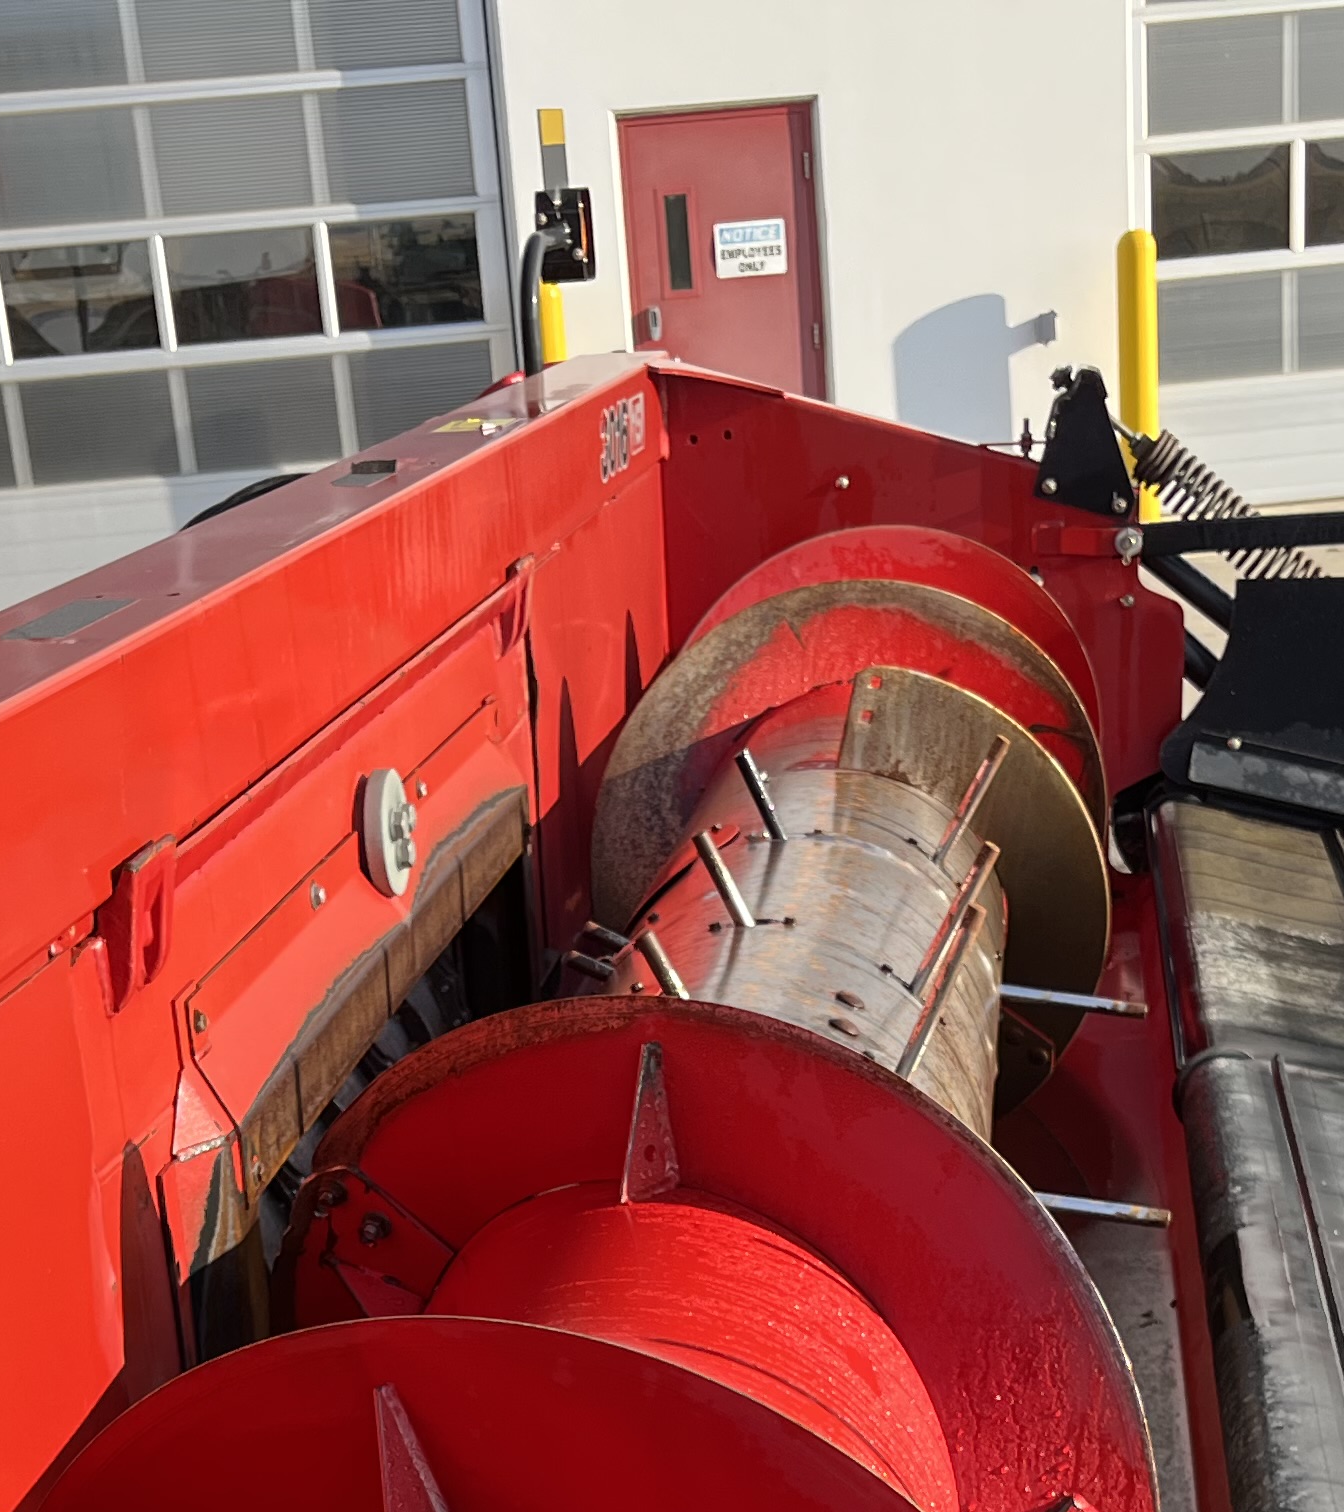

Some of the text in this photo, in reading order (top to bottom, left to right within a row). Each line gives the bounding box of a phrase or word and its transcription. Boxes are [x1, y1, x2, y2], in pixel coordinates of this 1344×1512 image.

[721, 225, 779, 243] NOTICE
[720, 245, 782, 260] EMPLOYEES
[738, 260, 765, 273] ONLY
